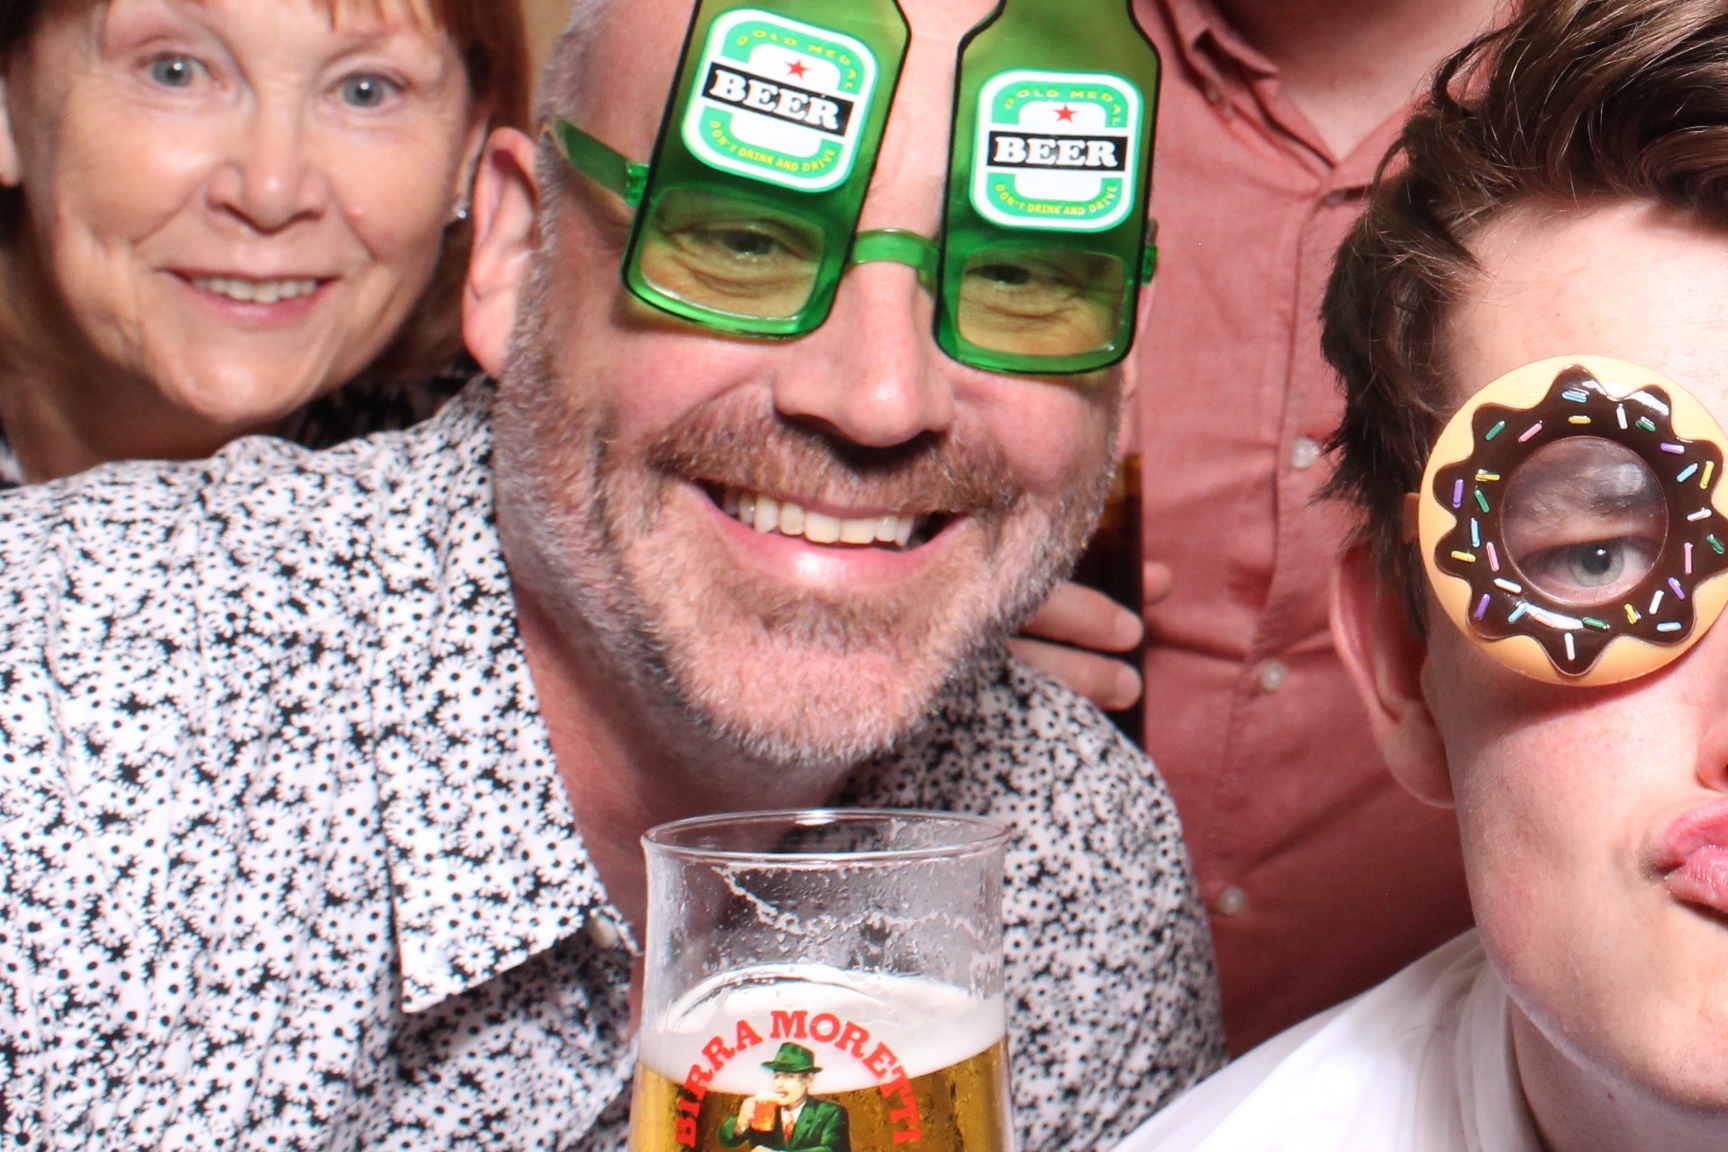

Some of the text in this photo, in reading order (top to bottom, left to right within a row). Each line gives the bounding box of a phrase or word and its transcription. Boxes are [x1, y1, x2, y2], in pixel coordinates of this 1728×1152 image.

[737, 28, 857, 89] GOLD MEDAL
[709, 69, 839, 130] BEER
[1004, 89, 1122, 125] GOLD MEDAL
[709, 120, 836, 172] DON'T DRINK AND DRIVE
[993, 136, 1118, 167] BEER
[995, 184, 1117, 216] DON'T DRINK AND DRIVE
[674, 1010, 922, 1148] BIRRA MORETTI
